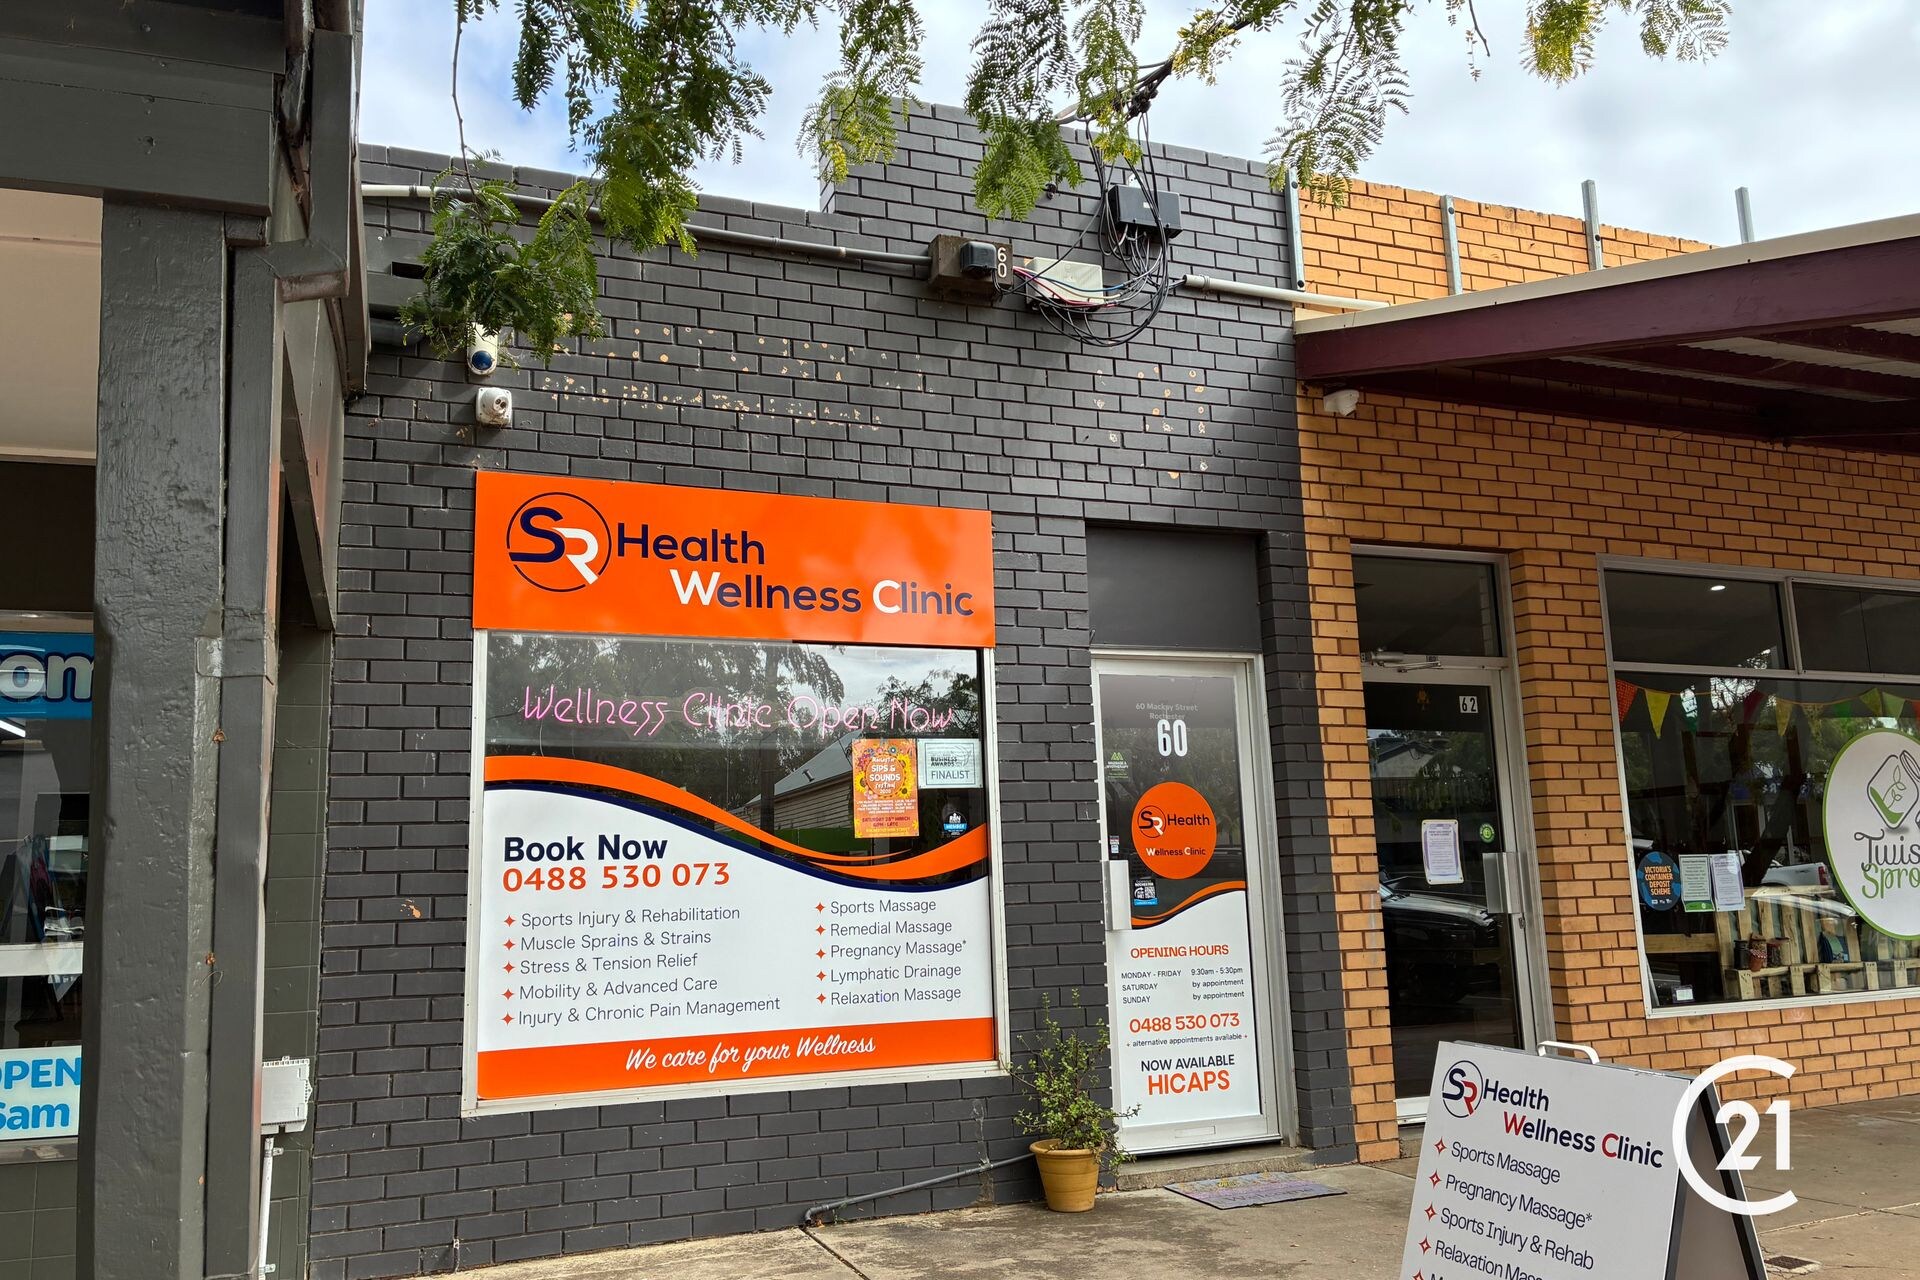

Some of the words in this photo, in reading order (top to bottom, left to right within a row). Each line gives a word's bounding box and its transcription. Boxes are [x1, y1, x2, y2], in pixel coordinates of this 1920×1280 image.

[998, 247, 1007, 277] 60
[617, 523, 765, 565] Health
[669, 569, 862, 614] Wellness
[872, 579, 975, 616] Clinic
[523, 685, 668, 736] Wellness
[682, 692, 771, 728] Clinic
[787, 695, 878, 738] Open
[889, 697, 953, 730] Now
[1135, 702, 1146, 710] 60
[1175, 703, 1198, 712] Street
[1461, 697, 1477, 712] 62
[1157, 719, 1188, 757] 60
[869, 773, 901, 782] SOUNDS
[871, 764, 889, 773] SIPS
[890, 764, 896, 772] &
[931, 770, 970, 780] FINALIST
[1167, 813, 1210, 826] Health
[503, 835, 585, 862] Book
[597, 834, 668, 861] Now
[1145, 847, 1183, 857] Wellness
[1184, 846, 1206, 856] Clinic
[1854, 828, 1920, 872] Twis
[502, 865, 587, 892] 0488
[601, 864, 661, 889] 530
[671, 862, 730, 887] 073
[1644, 873, 1674, 881] CONTAINER
[1649, 880, 1671, 888] DEPOSIT
[1861, 863, 1920, 899] Spro
[1650, 887, 1671, 896] SCHEME
[521, 912, 573, 930] Sports
[577, 910, 620, 928] Injury
[624, 909, 637, 924] &
[641, 906, 741, 923] Rehabilitation
[830, 901, 875, 917] Sports
[879, 899, 937, 914] Massage
[830, 921, 891, 937] Remedial
[895, 920, 953, 936] Massage
[520, 934, 576, 951] Muscle
[581, 932, 639, 951] Sprains
[643, 932, 656, 946] &
[660, 930, 712, 945] Strains
[1130, 945, 1187, 959] OPENING
[1189, 944, 1229, 957] HOURS
[830, 944, 902, 960] Pregnancy
[520, 959, 570, 975] Stress
[575, 958, 588, 972] &
[592, 955, 652, 971] Tension
[656, 952, 699, 968] Relief
[830, 966, 900, 985] Lymphatic
[904, 963, 962, 980] Drainage
[1121, 971, 1152, 979] MONDAY
[1157, 969, 1182, 977] FRIDAY
[1191, 968, 1215, 976] 9:30am
[1219, 967, 1244, 976] 5:30pm
[519, 984, 581, 1001] Mobility
[586, 982, 598, 997] &
[603, 978, 678, 996] Advanced
[683, 976, 718, 992] Care
[1122, 983, 1158, 992] SATURDAY
[1192, 980, 1201, 989] by
[1202, 978, 1244, 988] appointment
[831, 989, 900, 1006] Relaxation
[904, 987, 962, 1003] Massage
[1122, 996, 1151, 1004] SUNDAY
[1192, 993, 1202, 1001] by
[1203, 991, 1245, 1000] appointment
[518, 1010, 563, 1028] Injury
[567, 1008, 580, 1023] &
[585, 1004, 645, 1022] Chronic
[650, 1002, 681, 1018] Pain
[686, 997, 781, 1017] Management
[1129, 1016, 1172, 1033] 0488
[1175, 1014, 1207, 1031] 530
[1209, 1012, 1240, 1028] 073
[1132, 1038, 1168, 1047] alternative
[1169, 1036, 1214, 1045] appointments
[1214, 1033, 1242, 1042] available
[625, 1047, 657, 1071] We
[661, 1050, 707, 1068] care
[708, 1041, 741, 1074] for
[741, 1044, 791, 1073] your
[796, 1033, 877, 1058] Wellness
[1141, 1058, 1173, 1072] NOW
[1175, 1054, 1235, 1070] AVAILABLE
[0, 1056, 82, 1090] PEN
[1147, 1069, 1230, 1096] HICAPS
[1483, 1078, 1550, 1112] Health
[1502, 1110, 1596, 1154] Wellness
[1601, 1132, 1664, 1169] Clinic
[1450, 1141, 1495, 1168] Sports
[1497, 1152, 1561, 1184] Massage
[1445, 1174, 1518, 1212] Pregnancy
[1440, 1207, 1485, 1236] Sports
[1485, 1221, 1529, 1253] Injury
[1530, 1234, 1543, 1254] &
[1544, 1239, 1595, 1270] Rehab
[1435, 1239, 1503, 1278] Relaxation
